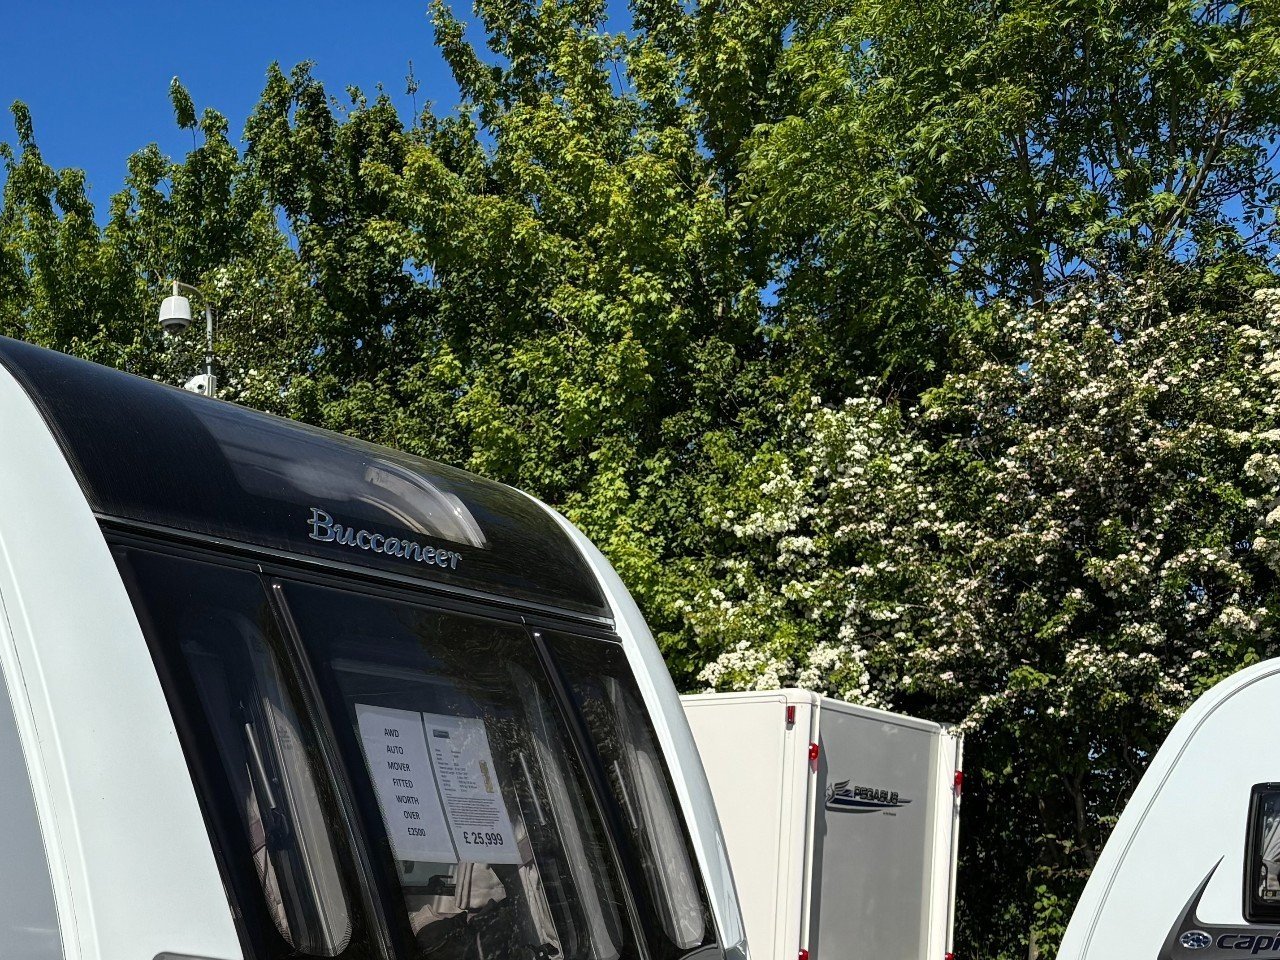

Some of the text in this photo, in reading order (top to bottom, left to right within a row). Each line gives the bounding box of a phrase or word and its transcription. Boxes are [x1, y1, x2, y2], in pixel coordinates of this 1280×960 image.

[307, 507, 462, 570] Buccaneer
[384, 728, 399, 738] AWD
[386, 745, 404, 755] AUTO
[387, 762, 411, 772] MOVER
[392, 778, 414, 789] FITTED
[396, 795, 419, 805] WORTH
[403, 811, 421, 820] OVER
[407, 827, 426, 837] £2500
[463, 831, 504, 847] £ 25,999
